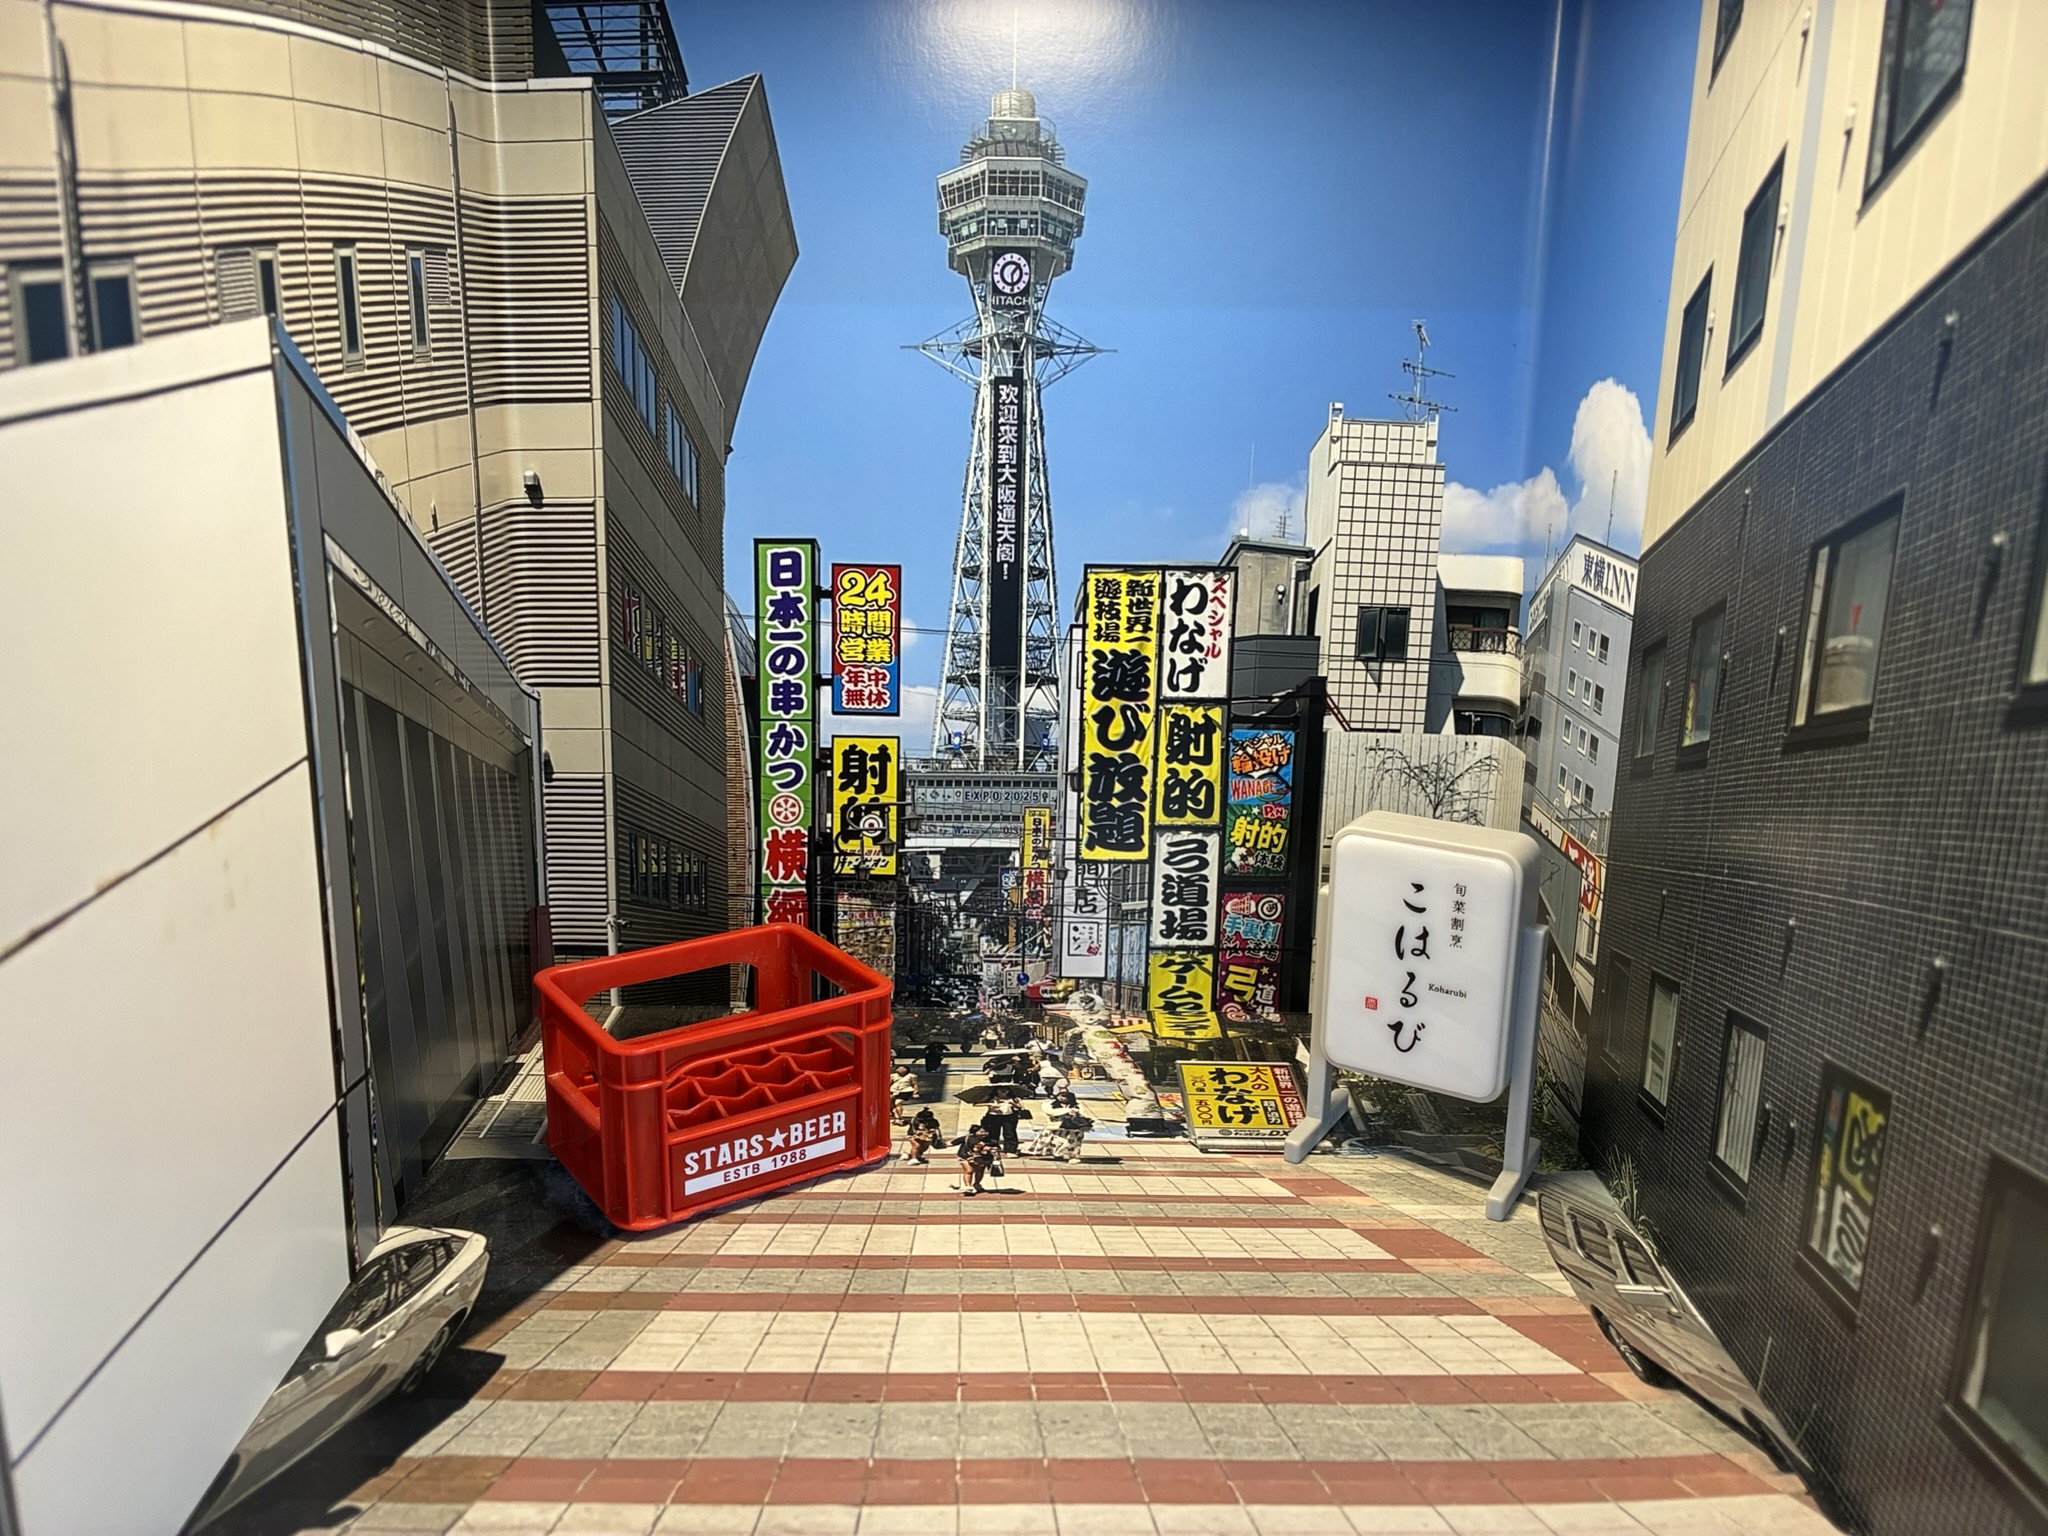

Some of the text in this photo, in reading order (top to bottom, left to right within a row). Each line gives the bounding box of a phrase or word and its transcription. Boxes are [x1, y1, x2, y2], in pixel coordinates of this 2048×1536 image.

[840, 571, 893, 608] 24
[840, 608, 893, 636] 時間
[1204, 576, 1228, 659] スペシャル
[839, 637, 892, 663] 営業
[1166, 578, 1210, 693] わなげ
[766, 548, 806, 791] 日本一の串かつ
[844, 668, 889, 687] 年中
[844, 688, 888, 706] 無休
[1086, 648, 1151, 852] 遊び放題
[1231, 746, 1291, 774] 輪投げ
[1232, 733, 1284, 752] スペシャル
[1162, 712, 1217, 819] 射的
[964, 791, 1042, 801] EXPO 2025
[1229, 815, 1289, 854] 射的
[1254, 850, 1286, 871] 体験
[1449, 883, 1467, 949] 旬菜割烹
[1387, 882, 1430, 1052] こはるび
[1428, 983, 1467, 999] Koharubi
[1208, 1067, 1260, 1125] わなげ
[1249, 1066, 1270, 1091] 大人の
[684, 1111, 846, 1176] STARS BEER
[723, 1149, 807, 1183] ESTB 1988
